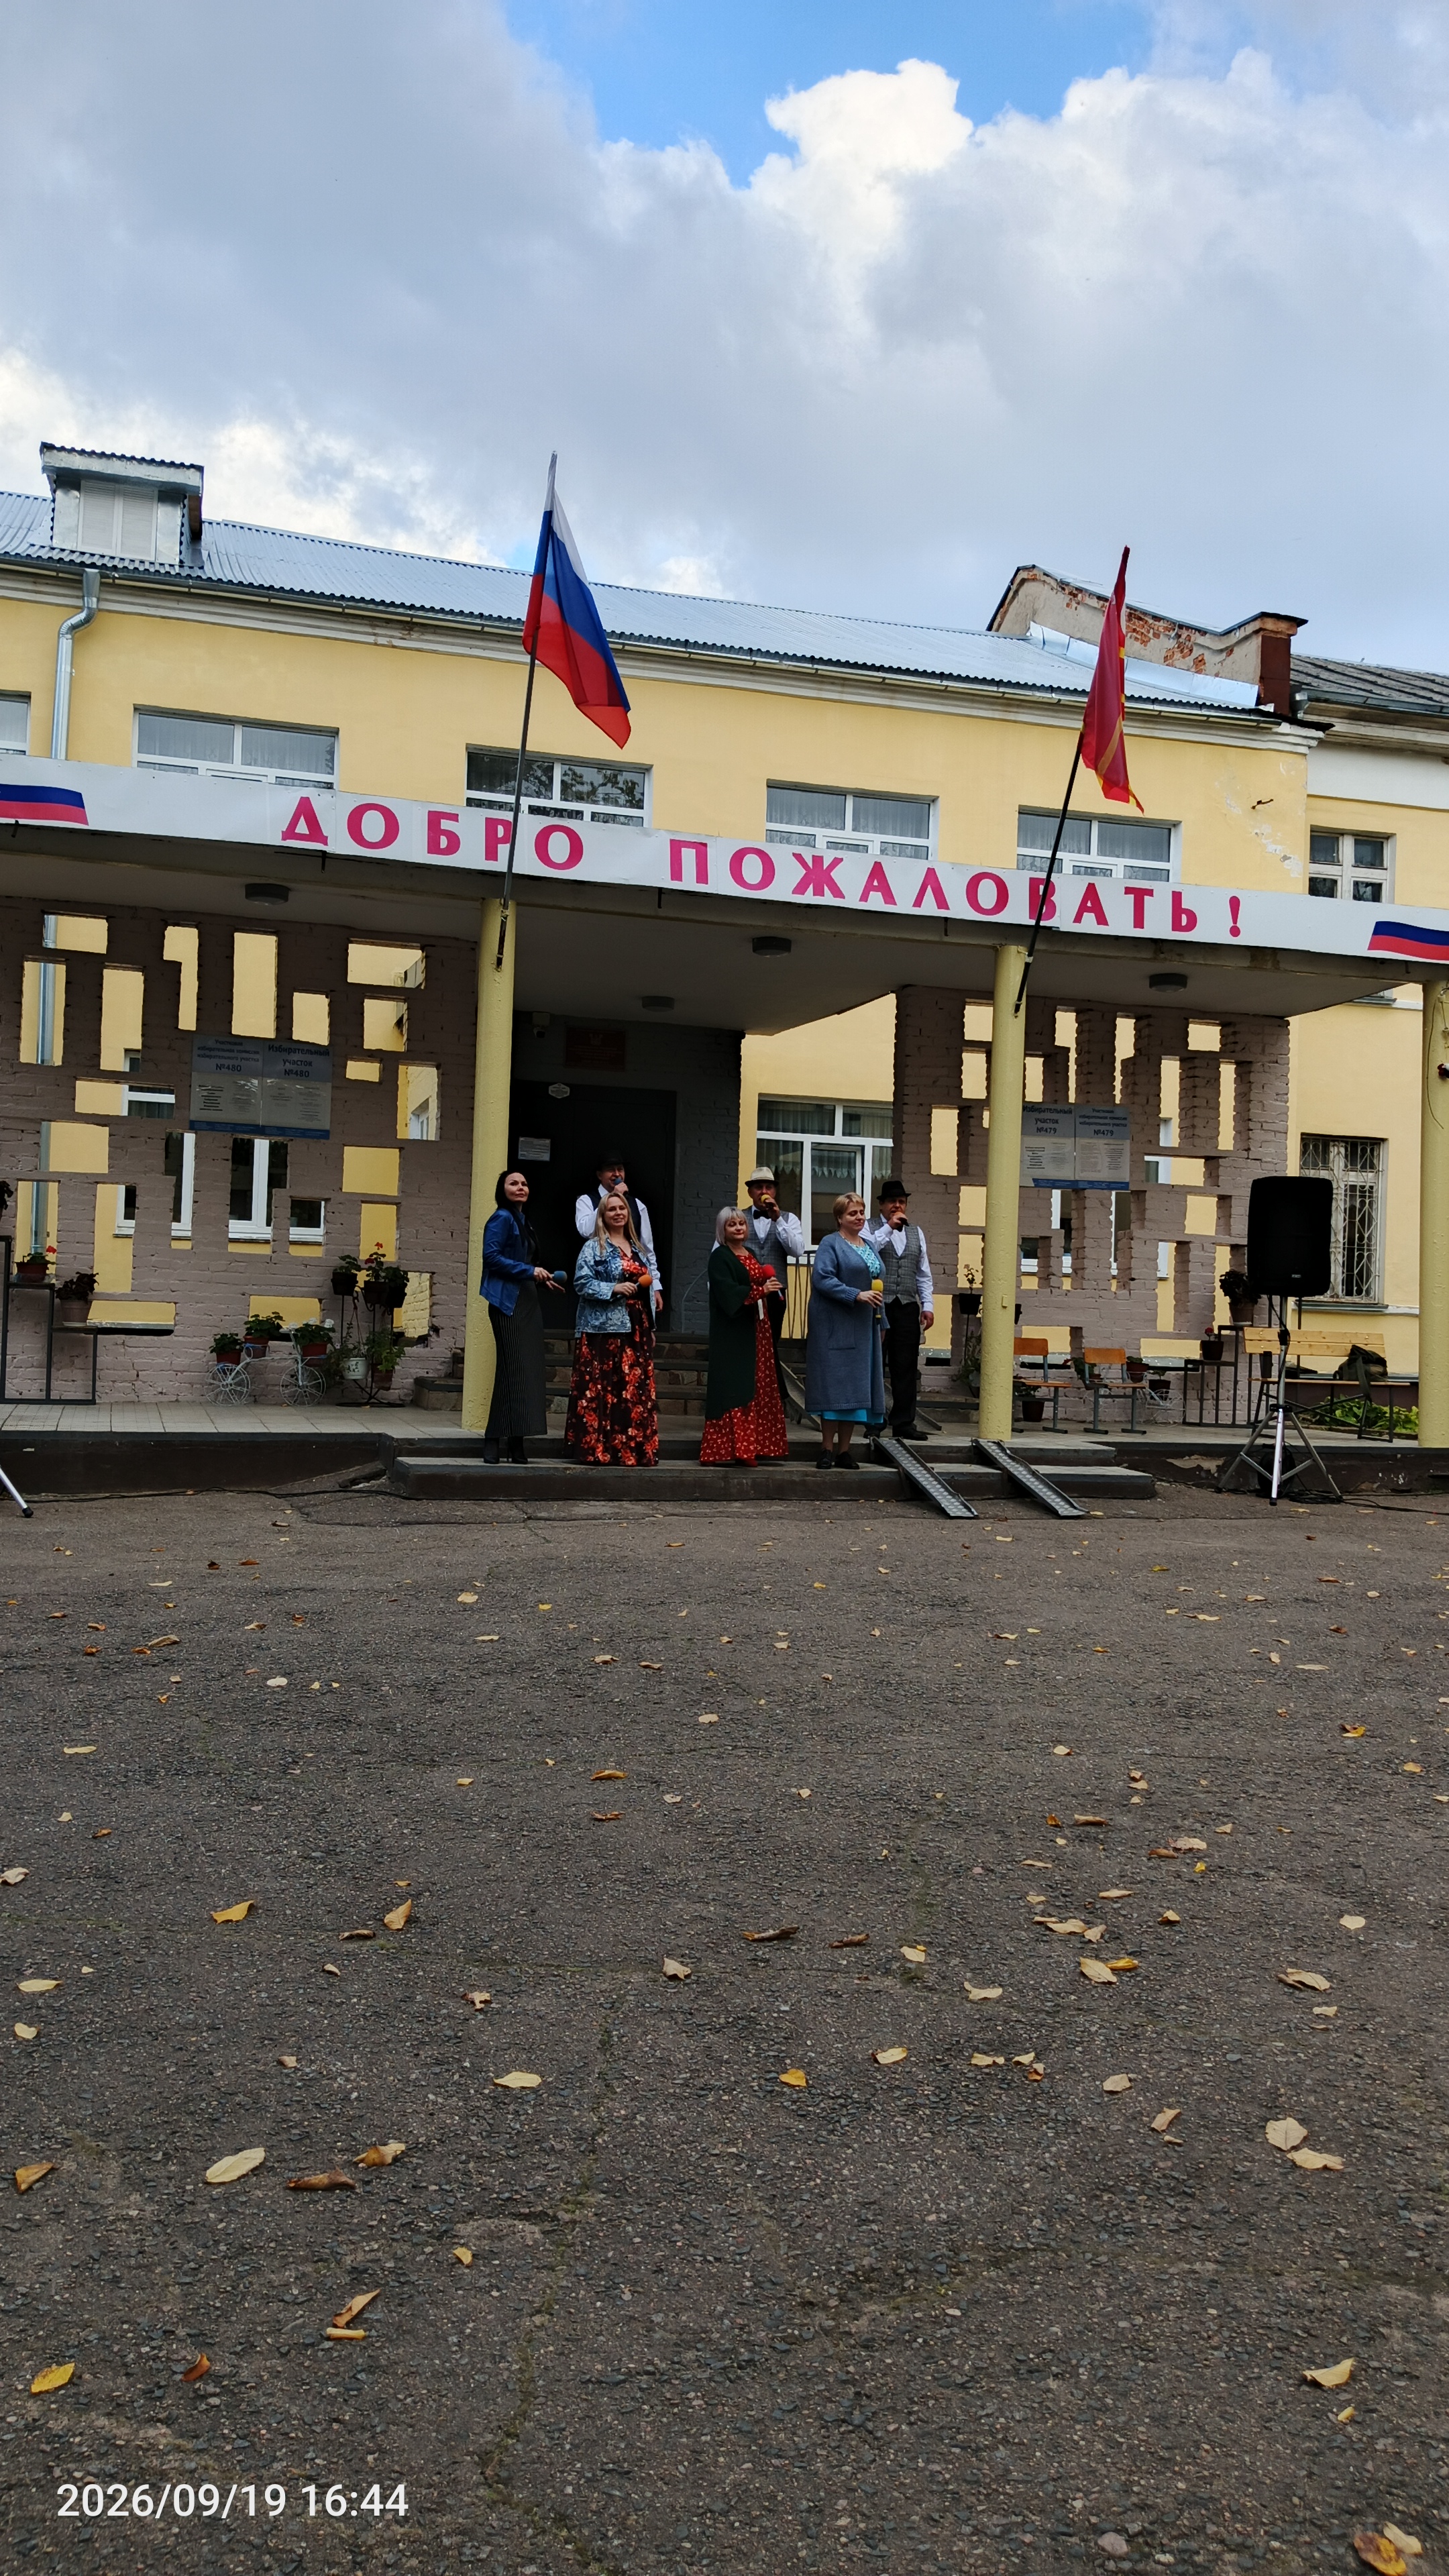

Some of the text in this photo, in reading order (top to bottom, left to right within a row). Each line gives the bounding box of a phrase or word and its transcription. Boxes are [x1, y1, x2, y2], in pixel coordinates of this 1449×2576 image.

[281, 796, 584, 871] ДОБРО
[268, 1044, 330, 1057] Избирательный
[215, 1063, 242, 1073] №480
[282, 1058, 313, 1068] участок
[284, 1068, 310, 1078] №480
[1023, 1105, 1073, 1115] Избирательный
[1034, 1117, 1059, 1125] участок
[1036, 1126, 1057, 1134] №479
